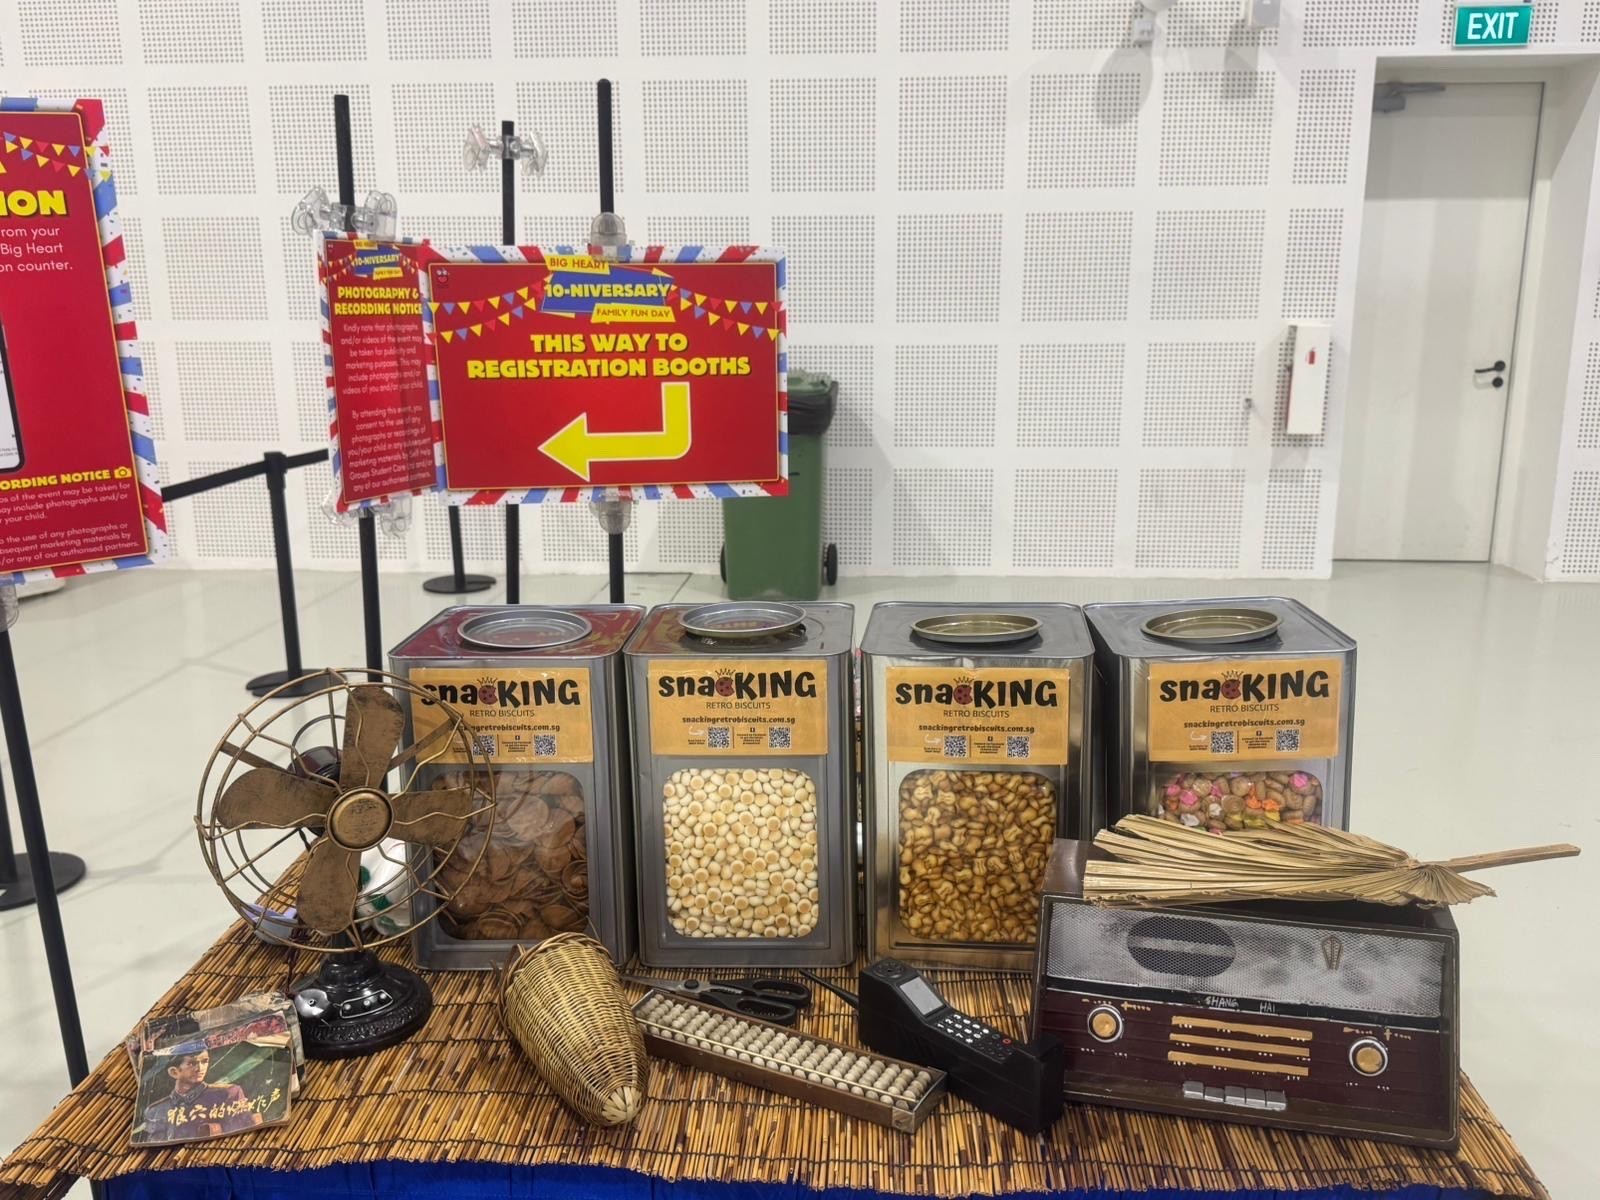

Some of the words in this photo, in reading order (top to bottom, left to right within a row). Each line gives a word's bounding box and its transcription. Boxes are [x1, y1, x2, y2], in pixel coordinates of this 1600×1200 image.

[1467, 12, 1520, 40] EXIT
[31, 227, 60, 242] your
[0, 243, 22, 258] Big
[26, 242, 64, 254] Heart
[17, 260, 73, 272] counter.
[549, 257, 568, 269] BIG
[572, 258, 607, 270] HEART
[337, 286, 411, 299] PHOTOGRAPHY
[544, 283, 672, 299] 10-NIVERSARY
[334, 302, 391, 315] RECORDING
[392, 303, 423, 315] NOTICE
[596, 307, 628, 318] FAMILY
[631, 307, 649, 317] FUN
[651, 308, 672, 318] DAY
[530, 334, 586, 353] THIS
[590, 333, 652, 353] WAY
[655, 333, 689, 352] TO
[467, 359, 648, 379] REGISTRATION
[652, 357, 751, 377] BOOTHS
[0, 475, 58, 491] ORDING
[60, 470, 111, 484] NOTICE
[10, 493, 19, 502] of
[21, 491, 36, 500] the
[38, 490, 61, 499] event
[63, 489, 80, 498] may
[82, 485, 93, 494] be
[95, 483, 118, 493] taken
[119, 482, 131, 490] for
[13, 502, 44, 512] include
[46, 496, 98, 510] photographs
[100, 492, 128, 503] and/or
[4, 516, 22, 525] your
[6, 535, 21, 543] the
[39, 531, 48, 539] of
[50, 530, 65, 539] any
[67, 523, 118, 537] photographs
[40, 537, 82, 550] marketing
[83, 533, 120, 543] materials
[121, 531, 131, 540] by
[16, 555, 32, 563] any
[33, 552, 43, 560] of
[706, 701, 733, 710] RETRO
[735, 701, 771, 710] BISCUITS
[1209, 704, 1238, 713] RETRO
[1240, 703, 1280, 713] BISCUITS
[469, 709, 496, 718] RETRO
[498, 709, 536, 718] BISCUITS
[943, 709, 970, 718] RETRO
[972, 710, 1010, 718] BISCUITS
[682, 716, 796, 725] snackingretrobiscuits.com.sg
[1183, 718, 1305, 729] snackingretrobiscuits.com.sg
[918, 724, 1035, 733] snackingretrobiscuits.com.sg
[1205, 996, 1239, 1008] SHANG
[1260, 1002, 1276, 1013] HAI
